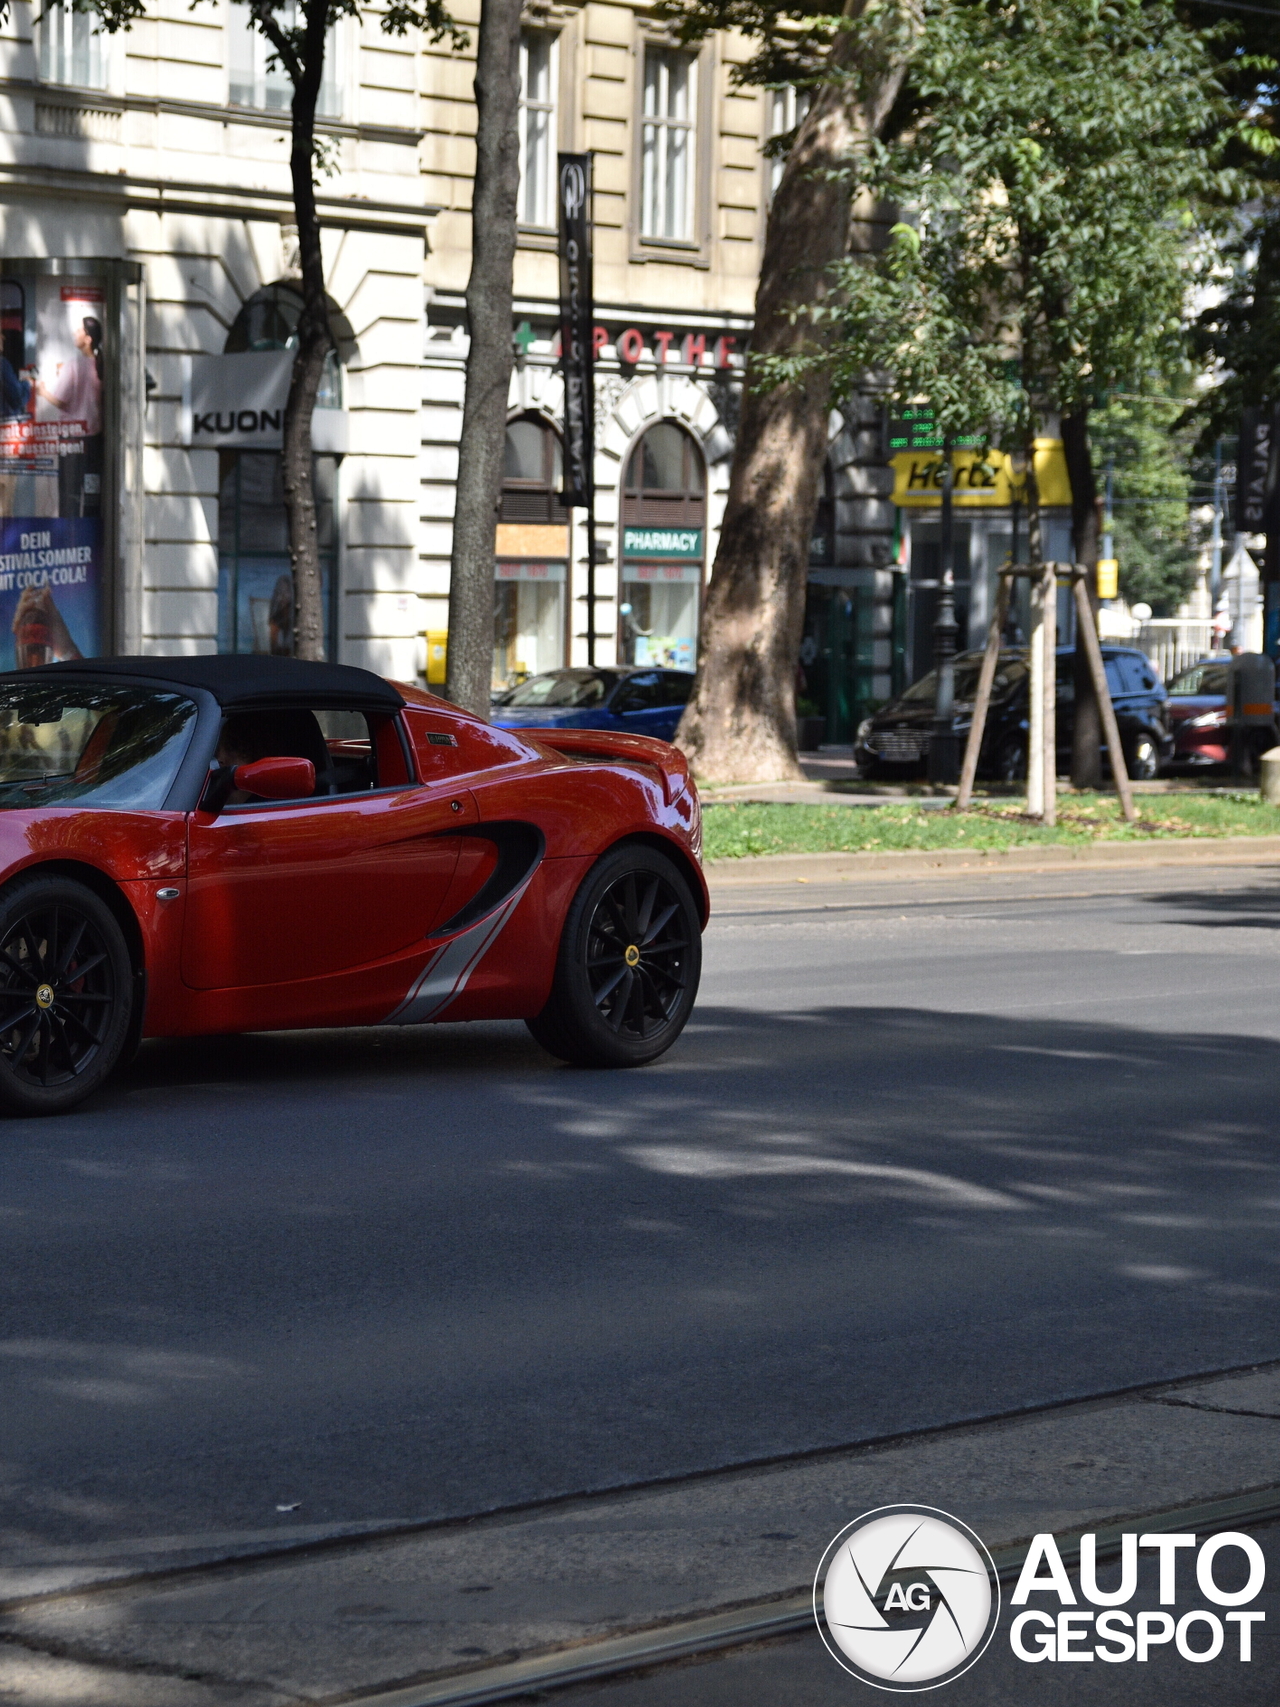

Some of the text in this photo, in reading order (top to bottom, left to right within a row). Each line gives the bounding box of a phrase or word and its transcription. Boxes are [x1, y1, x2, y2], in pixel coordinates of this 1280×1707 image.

[193, 410, 287, 434] KUON
[907, 461, 1002, 488] Hertz
[20, 531, 51, 551] DEIN
[624, 531, 698, 551] PHARMACY
[16, 566, 87, 589] COCA-COLA!
